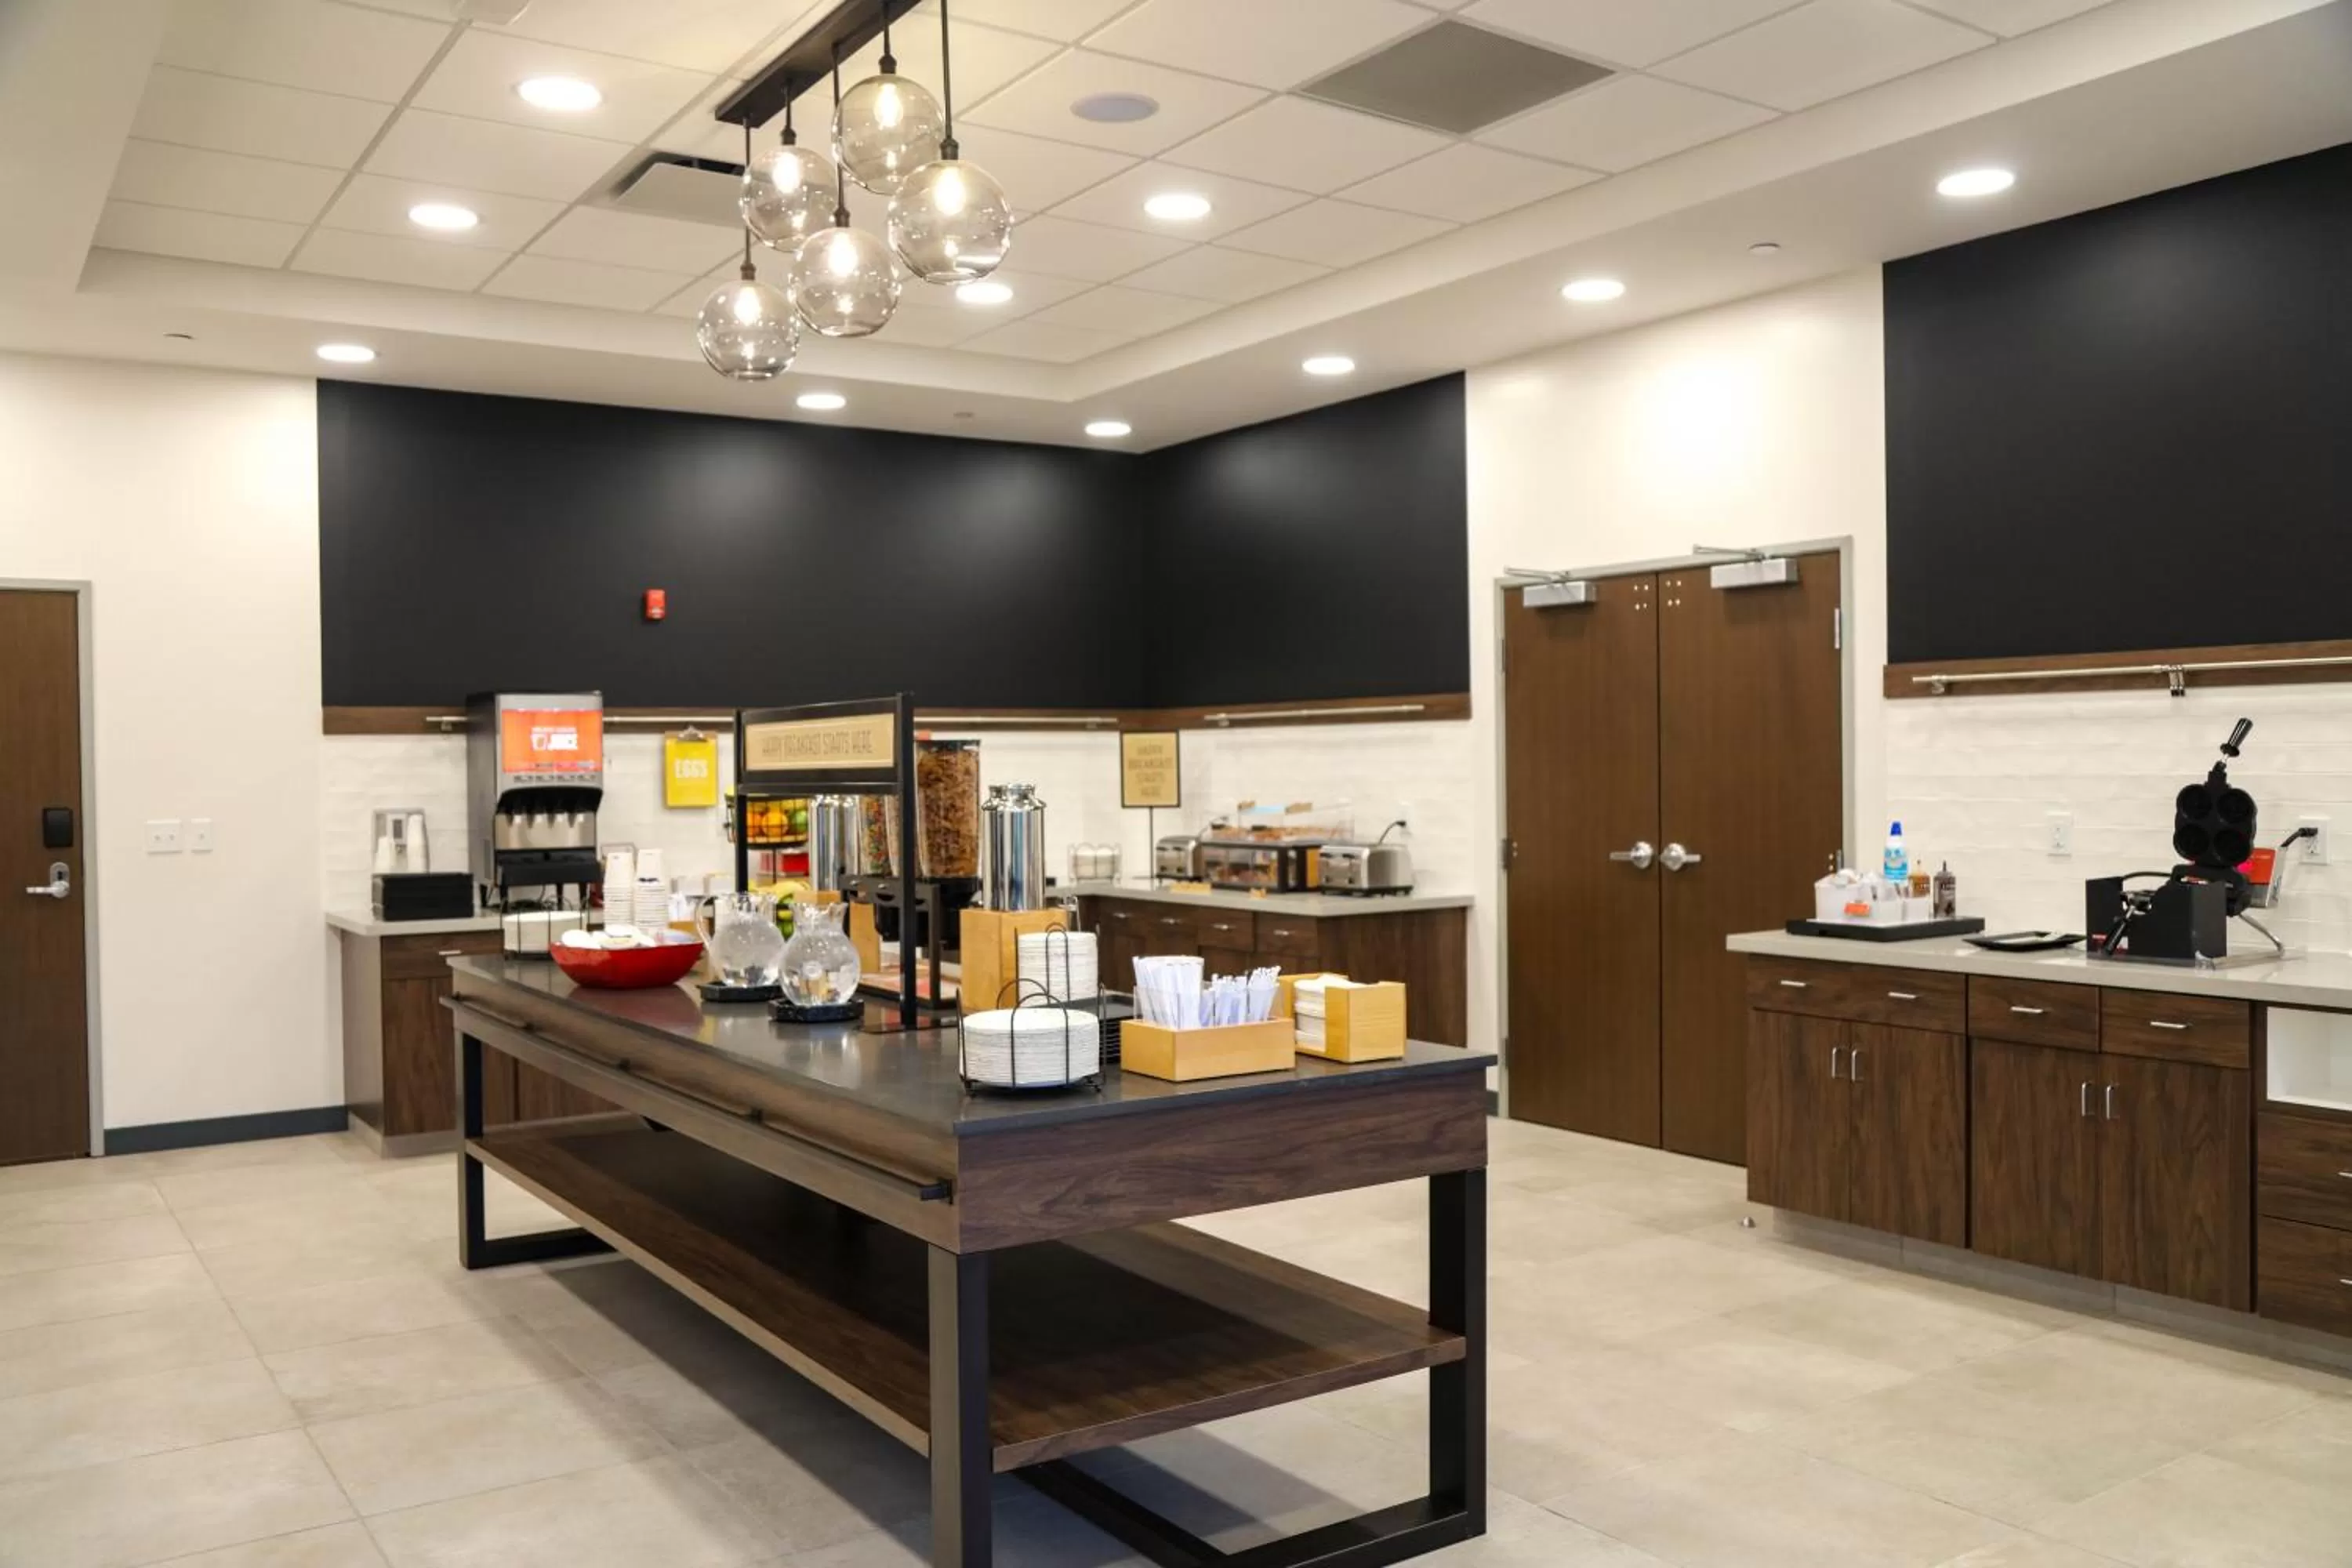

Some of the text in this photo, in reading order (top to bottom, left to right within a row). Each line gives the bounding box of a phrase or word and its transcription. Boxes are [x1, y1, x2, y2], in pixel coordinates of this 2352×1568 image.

[822, 731, 850, 754] STARTS
[851, 729, 873, 753] HERE
[675, 758, 708, 779] EGGS
